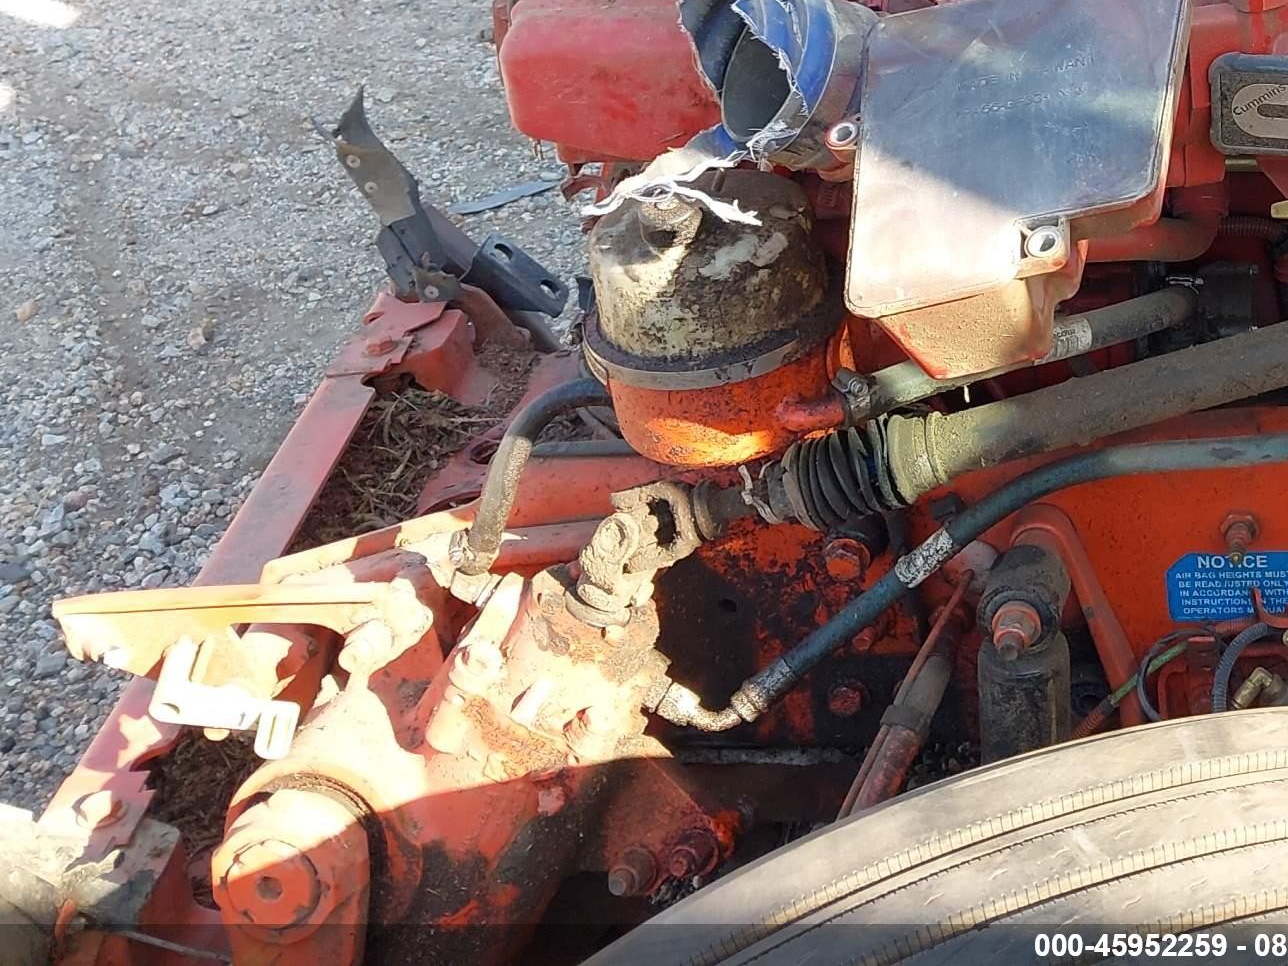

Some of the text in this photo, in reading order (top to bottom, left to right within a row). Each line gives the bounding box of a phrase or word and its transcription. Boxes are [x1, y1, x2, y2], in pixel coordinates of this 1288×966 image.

[1232, 83, 1288, 117] Cummins
[1197, 555, 1268, 569] NOCE
[1194, 571, 1216, 579] BAG
[1218, 571, 1262, 579] HEIGHTS
[1178, 580, 1192, 588] BE
[1262, 579, 1288, 587] ONLY
[1180, 588, 1288, 597] IN ACCORDAN WITH
[1270, 597, 1288, 605] THE
[1183, 606, 1245, 615] OPERATORS
